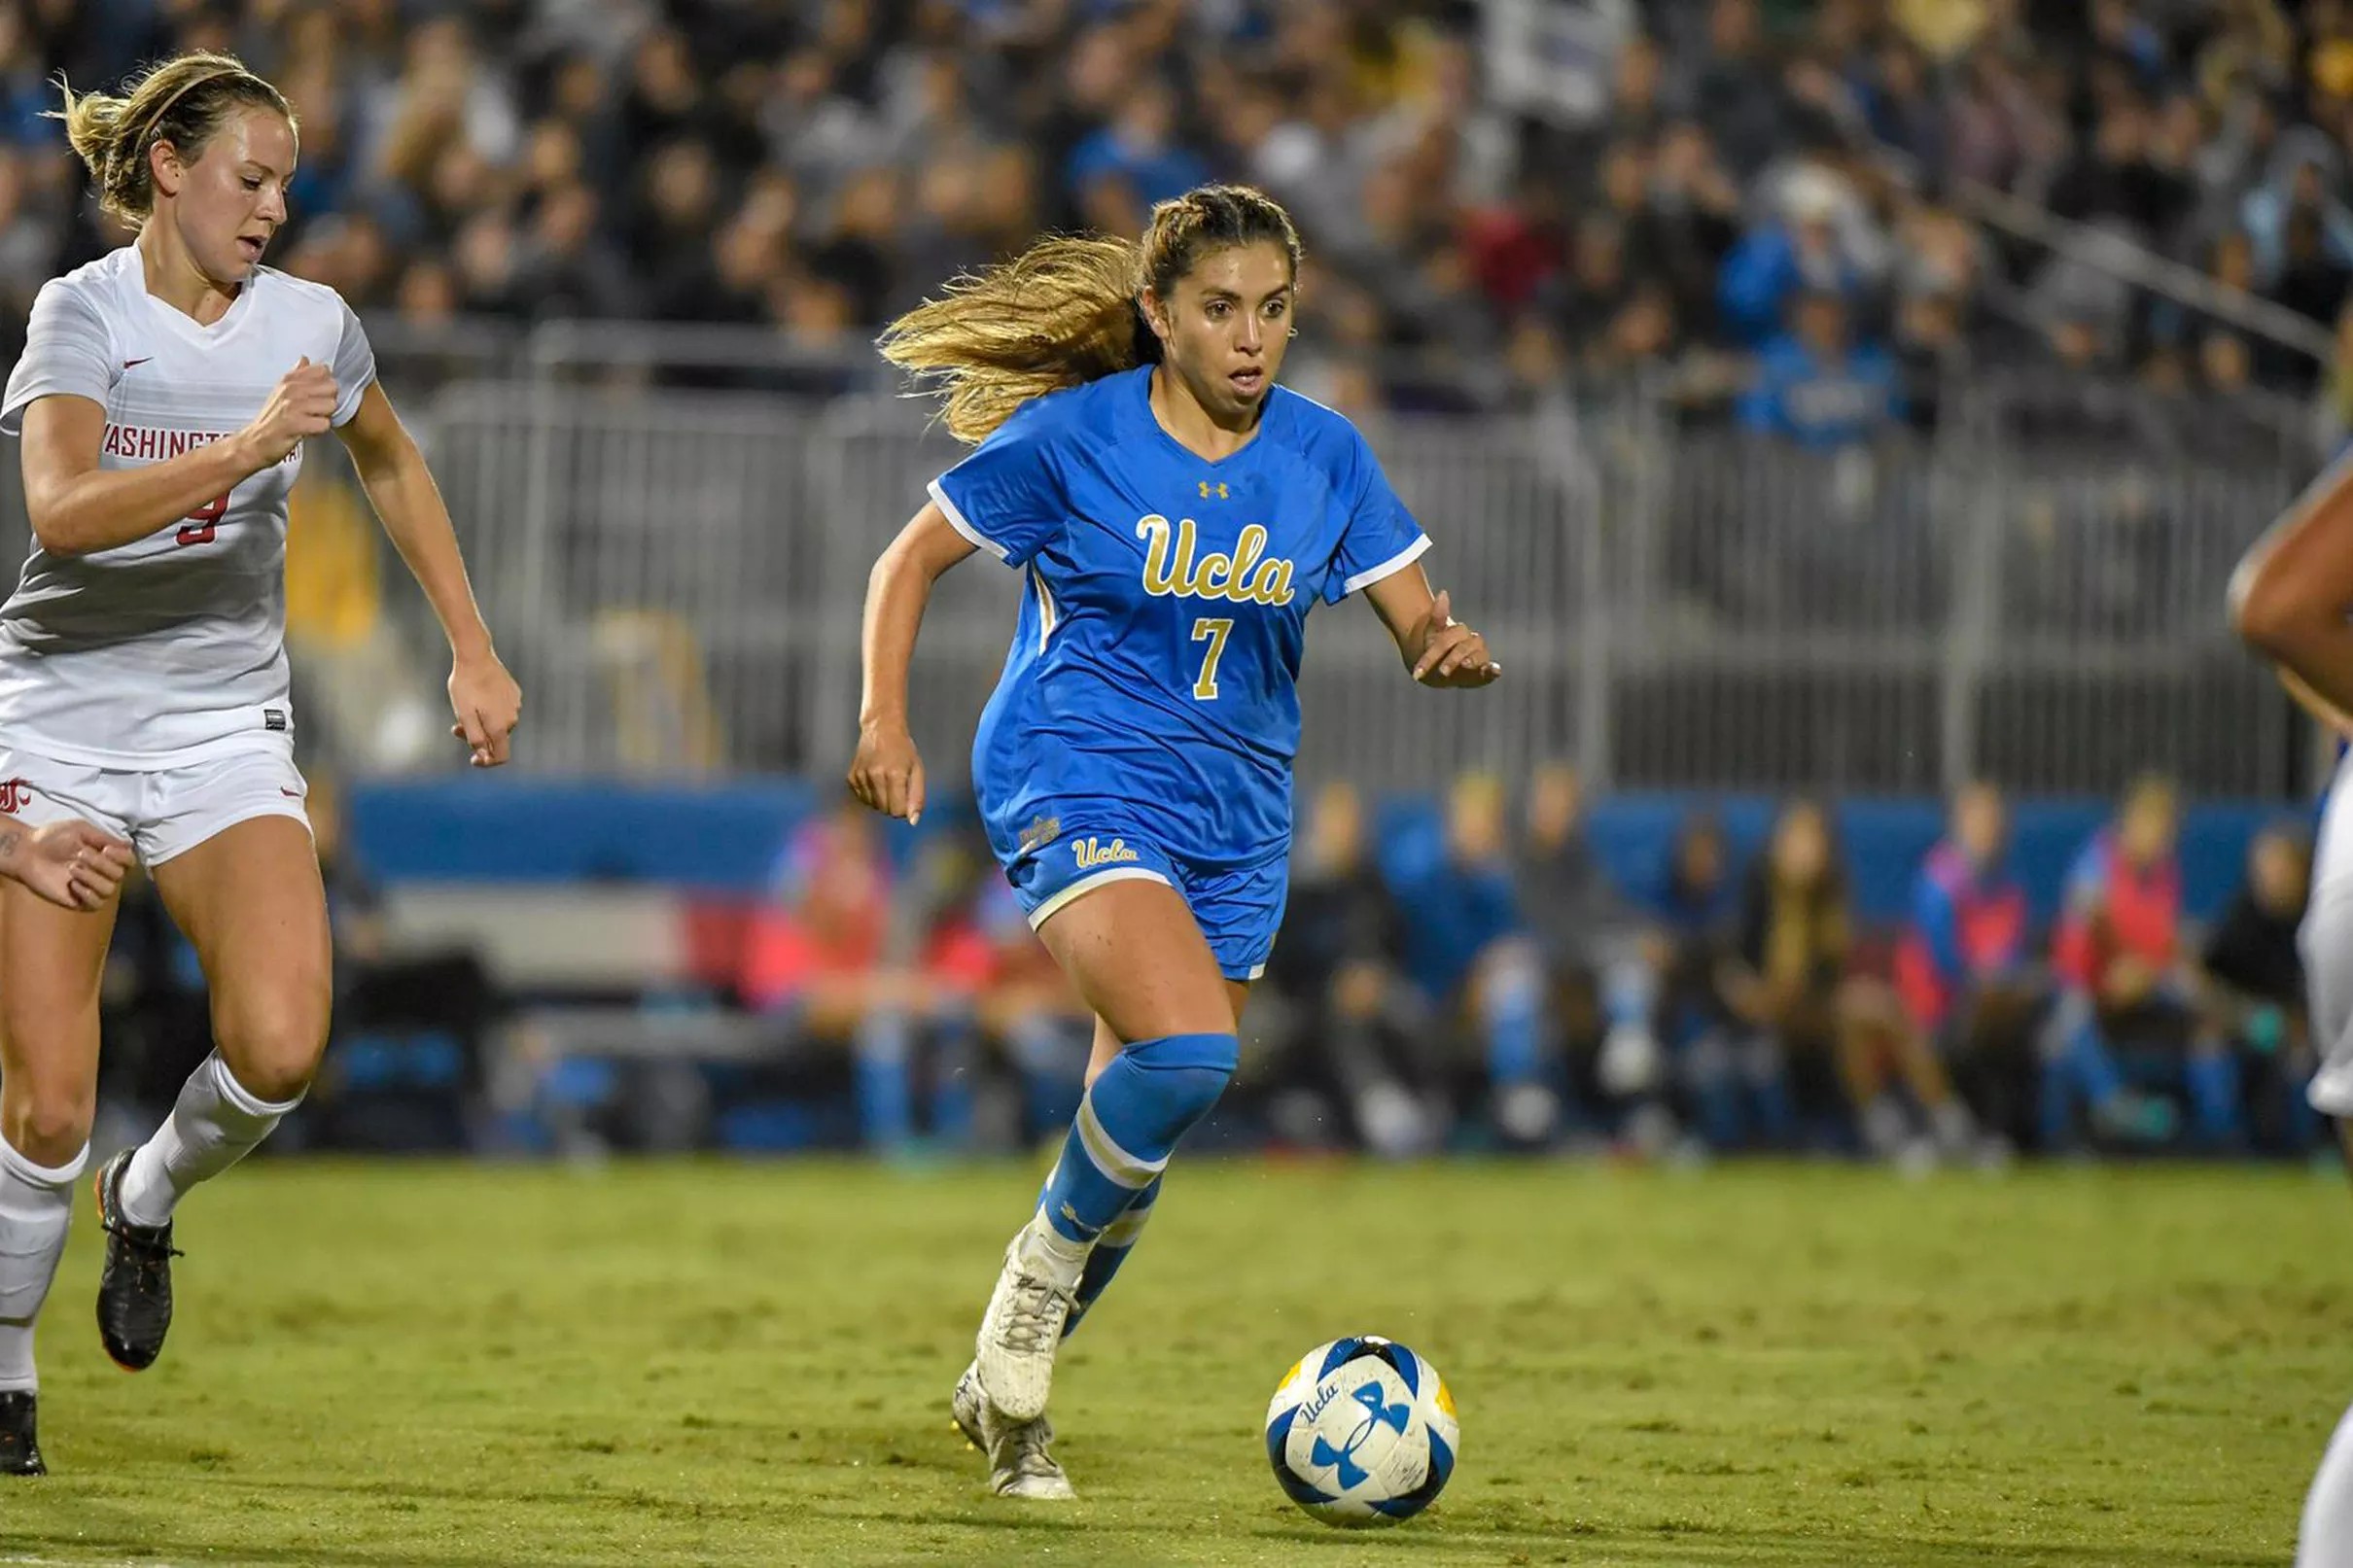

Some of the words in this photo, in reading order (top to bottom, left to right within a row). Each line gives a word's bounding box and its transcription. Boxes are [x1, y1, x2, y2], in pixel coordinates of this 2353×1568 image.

[105, 424, 231, 459] ASHING
[176, 488, 229, 545] 9
[1136, 513, 1295, 606] Ucla
[1191, 618, 1234, 700] 7
[1071, 837, 1140, 868] Ucla
[1300, 1385, 1339, 1426] Ucla
